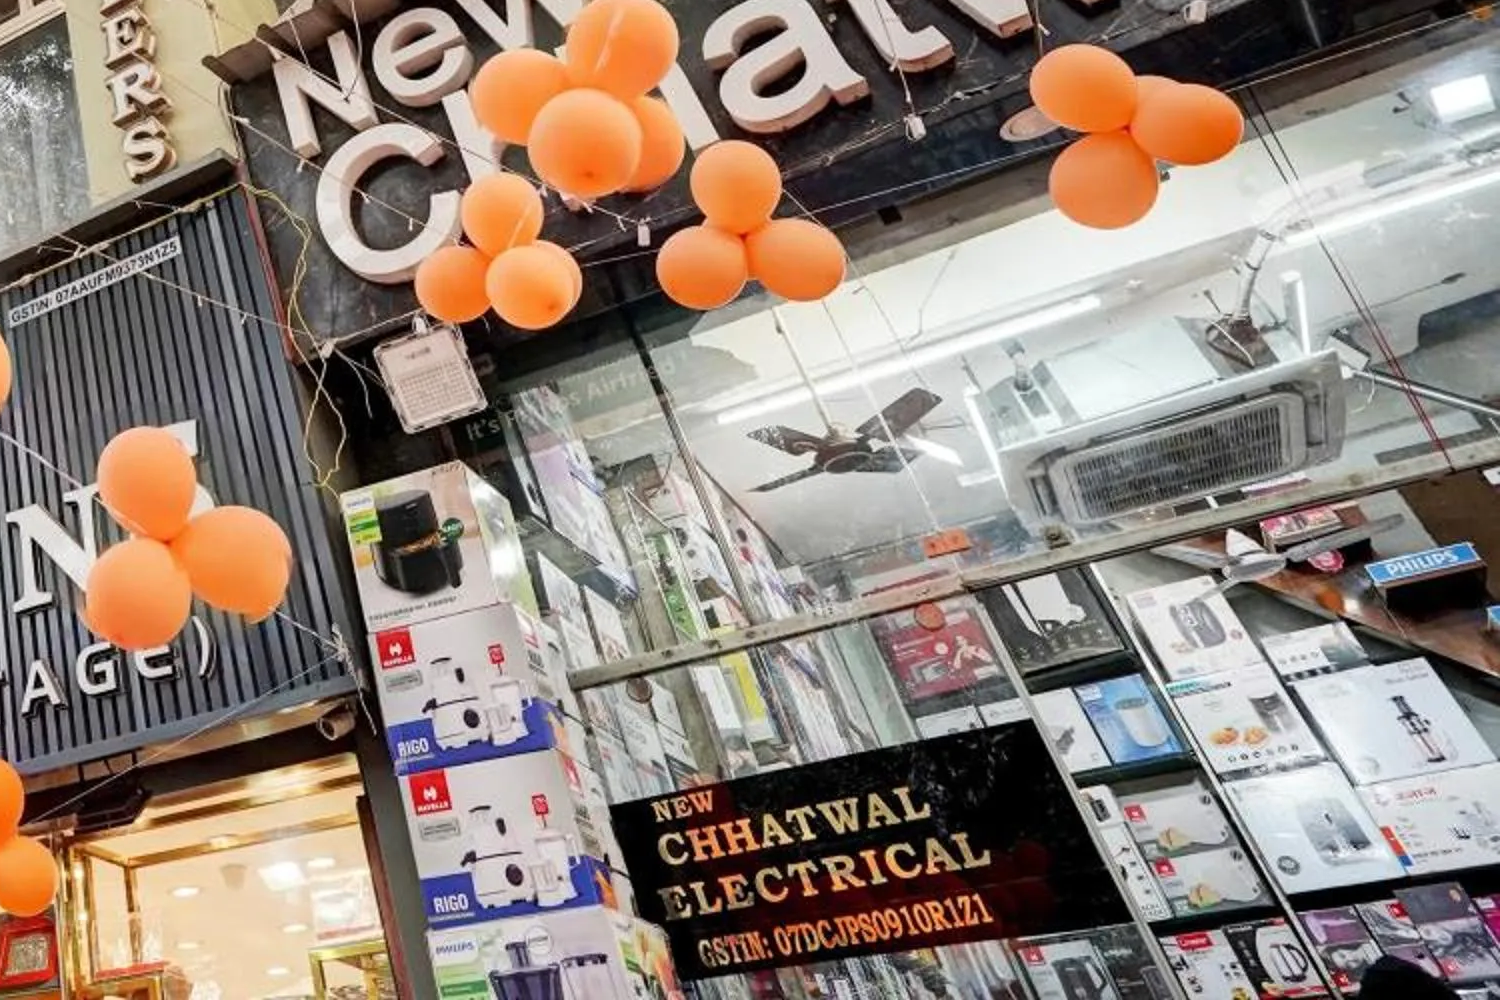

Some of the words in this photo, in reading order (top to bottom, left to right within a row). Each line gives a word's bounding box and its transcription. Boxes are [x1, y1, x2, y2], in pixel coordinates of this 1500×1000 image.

[1384, 550, 1461, 577] PHILIPS
[397, 737, 430, 758] RIGO
[651, 790, 714, 823] NEW
[657, 786, 932, 866] CHHATWAL
[656, 832, 992, 921] ELECTRICAL
[433, 893, 469, 914] RIGO
[435, 941, 475, 955] PHILIPS
[698, 930, 773, 969] GSTIN:
